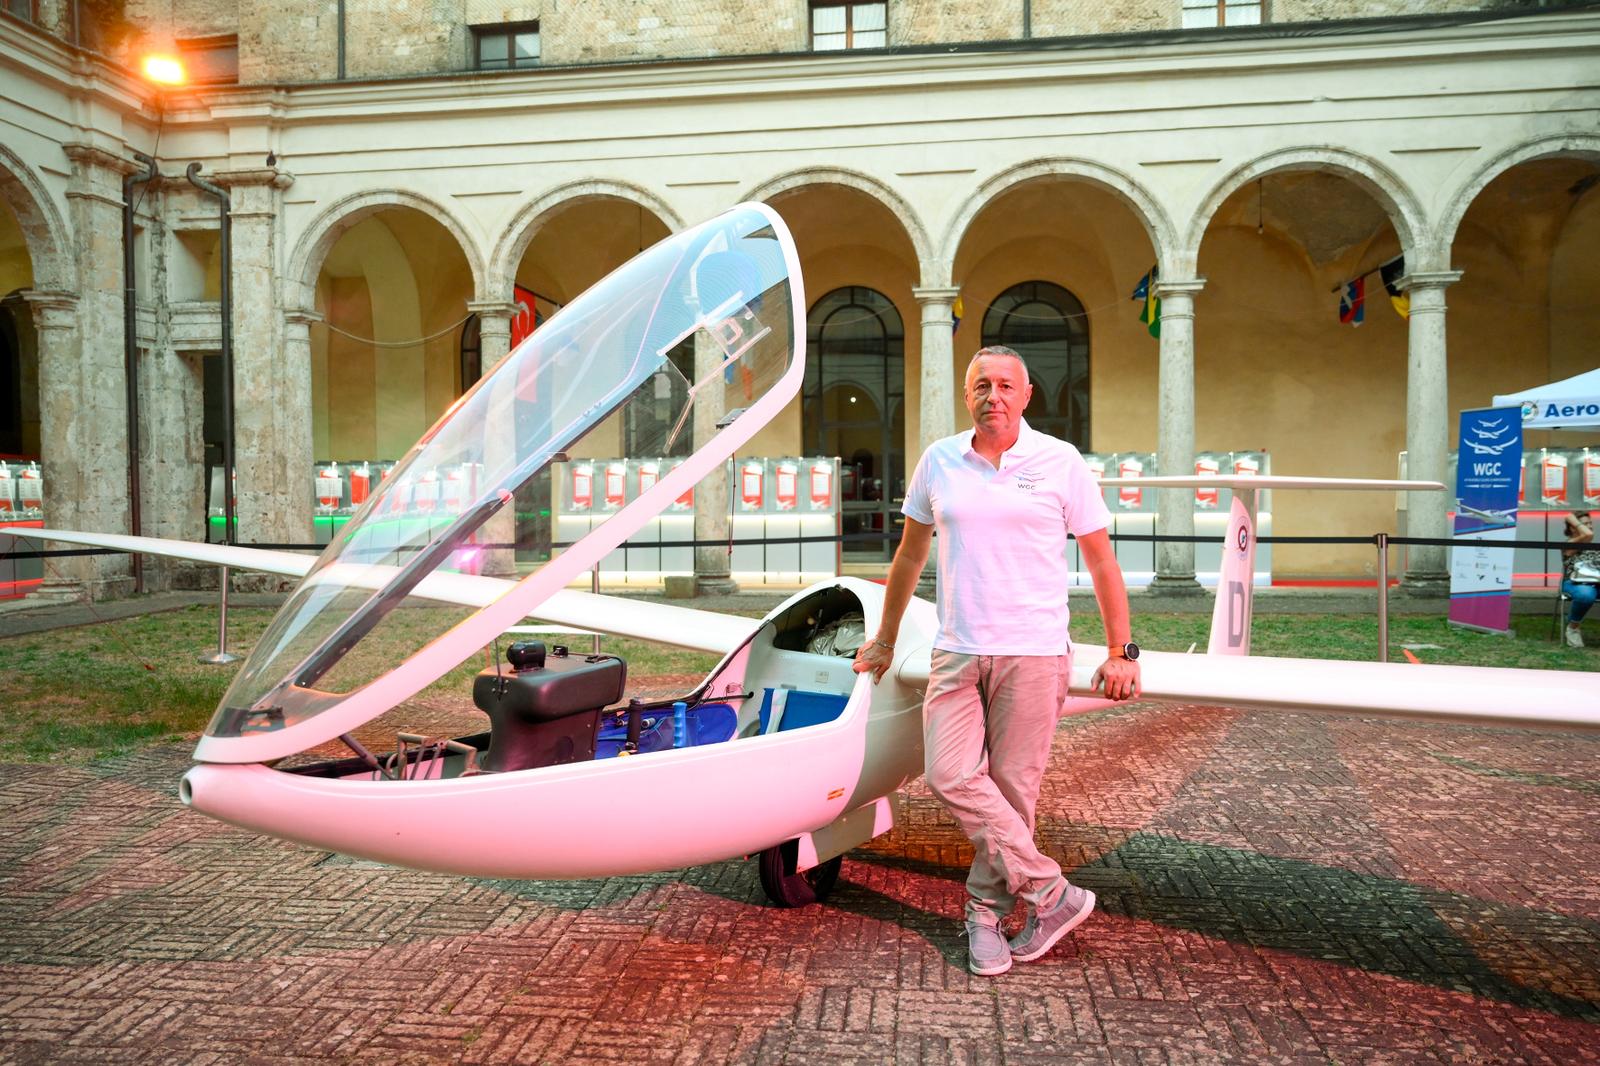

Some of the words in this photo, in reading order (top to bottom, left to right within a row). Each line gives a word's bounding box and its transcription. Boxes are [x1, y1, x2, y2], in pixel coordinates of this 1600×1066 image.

[1544, 403, 1600, 417] Aero
[1473, 463, 1502, 476] WGC
[1228, 581, 1245, 647] D
